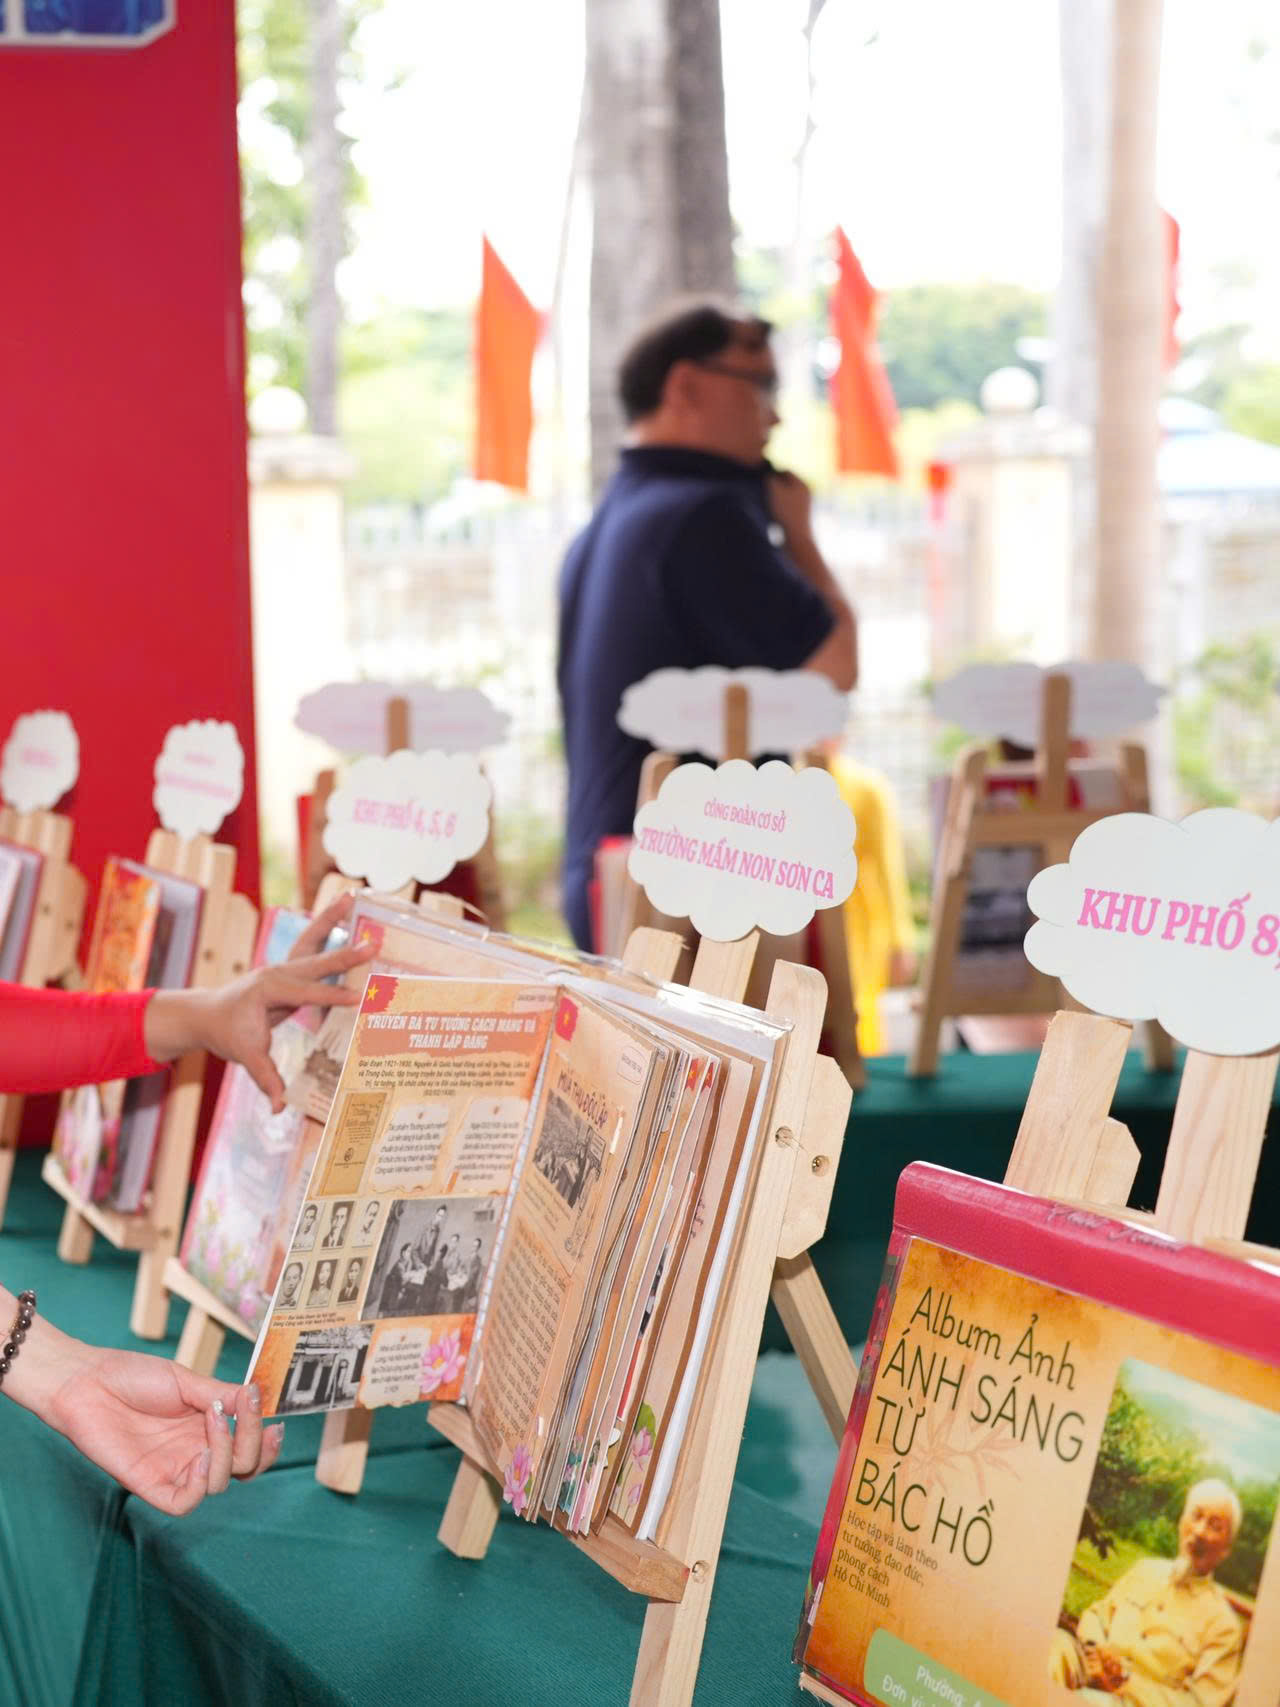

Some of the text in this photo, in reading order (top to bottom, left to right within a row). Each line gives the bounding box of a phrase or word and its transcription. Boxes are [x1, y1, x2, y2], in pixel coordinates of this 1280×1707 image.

[704, 797, 787, 833] CÔNG ĐOÀN CƠ SỞ
[639, 825, 835, 899] TRƯỜNG MẦM NON SƠN CA
[1077, 887, 1162, 937] KHU
[1161, 892, 1252, 951] PHỐ
[909, 1286, 1075, 1391] Album Ảnh
[875, 1395, 926, 1457] TỪ
[882, 1328, 1085, 1462] ÁNH SÁNG
[855, 1458, 996, 1567] BÁC HỒ
[837, 1548, 891, 1587] phong cách
[915, 1549, 938, 1571] theo
[865, 1583, 891, 1608] Minh
[881, 1674, 908, 1703] Đơn
